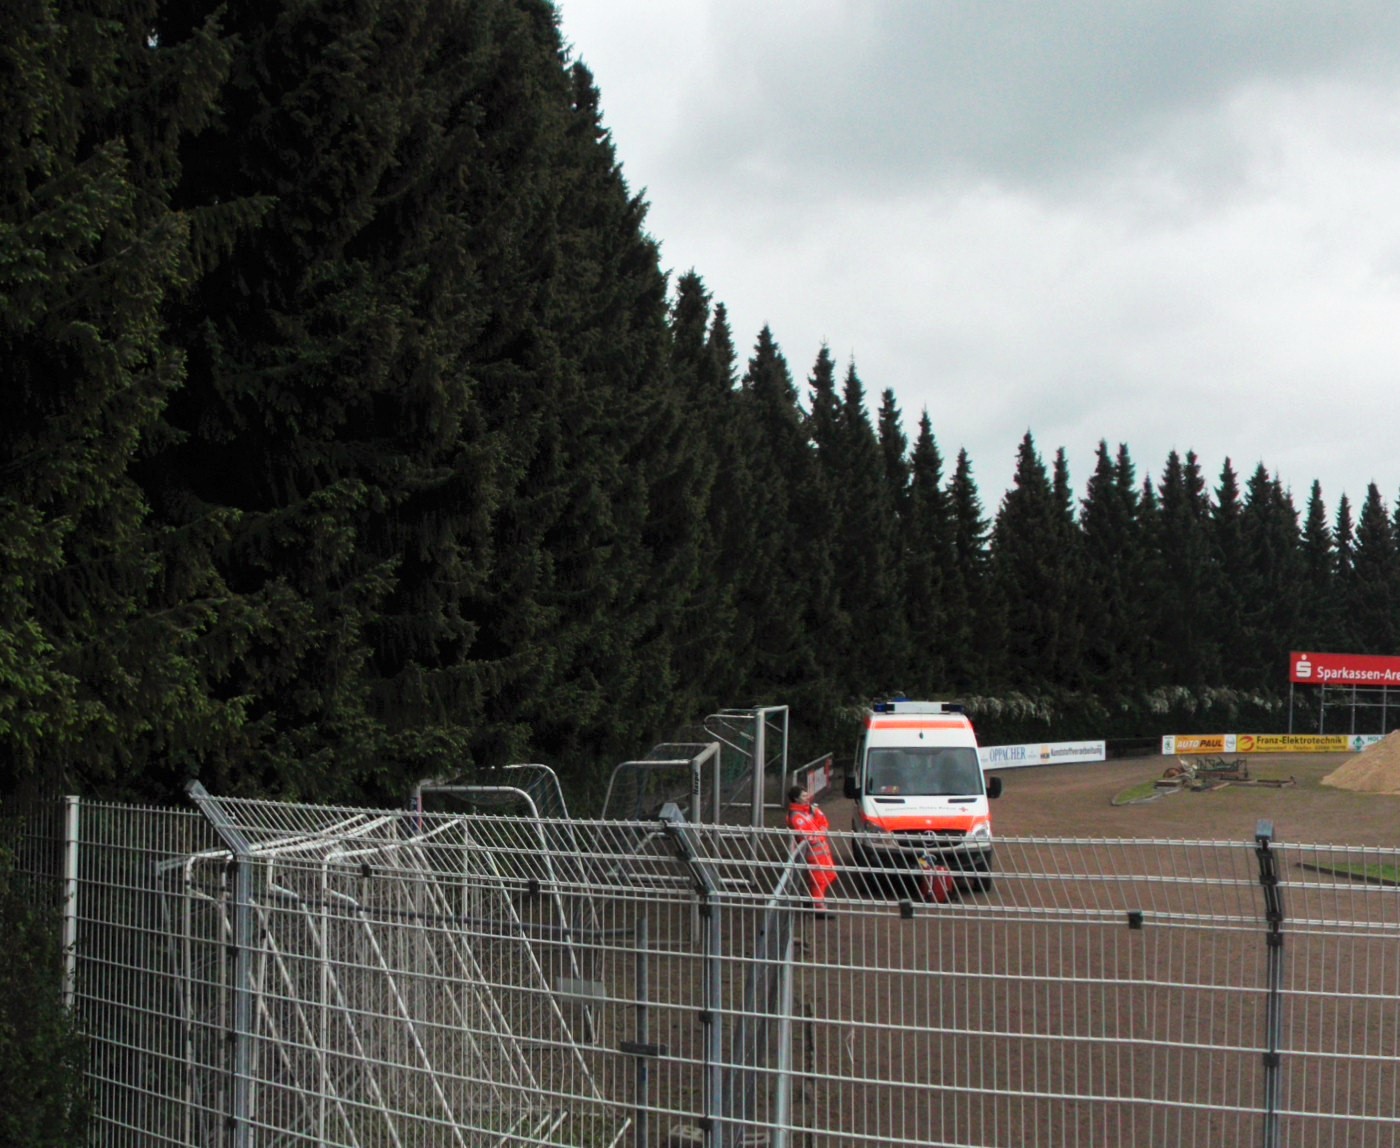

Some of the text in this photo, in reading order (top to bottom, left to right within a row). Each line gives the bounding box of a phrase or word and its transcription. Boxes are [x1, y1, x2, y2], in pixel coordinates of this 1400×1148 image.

[1177, 739, 1224, 749] AUTO PAUL
[1256, 735, 1342, 745] Franz-Elektrotechnik
[989, 746, 1027, 763] OPPACHER
